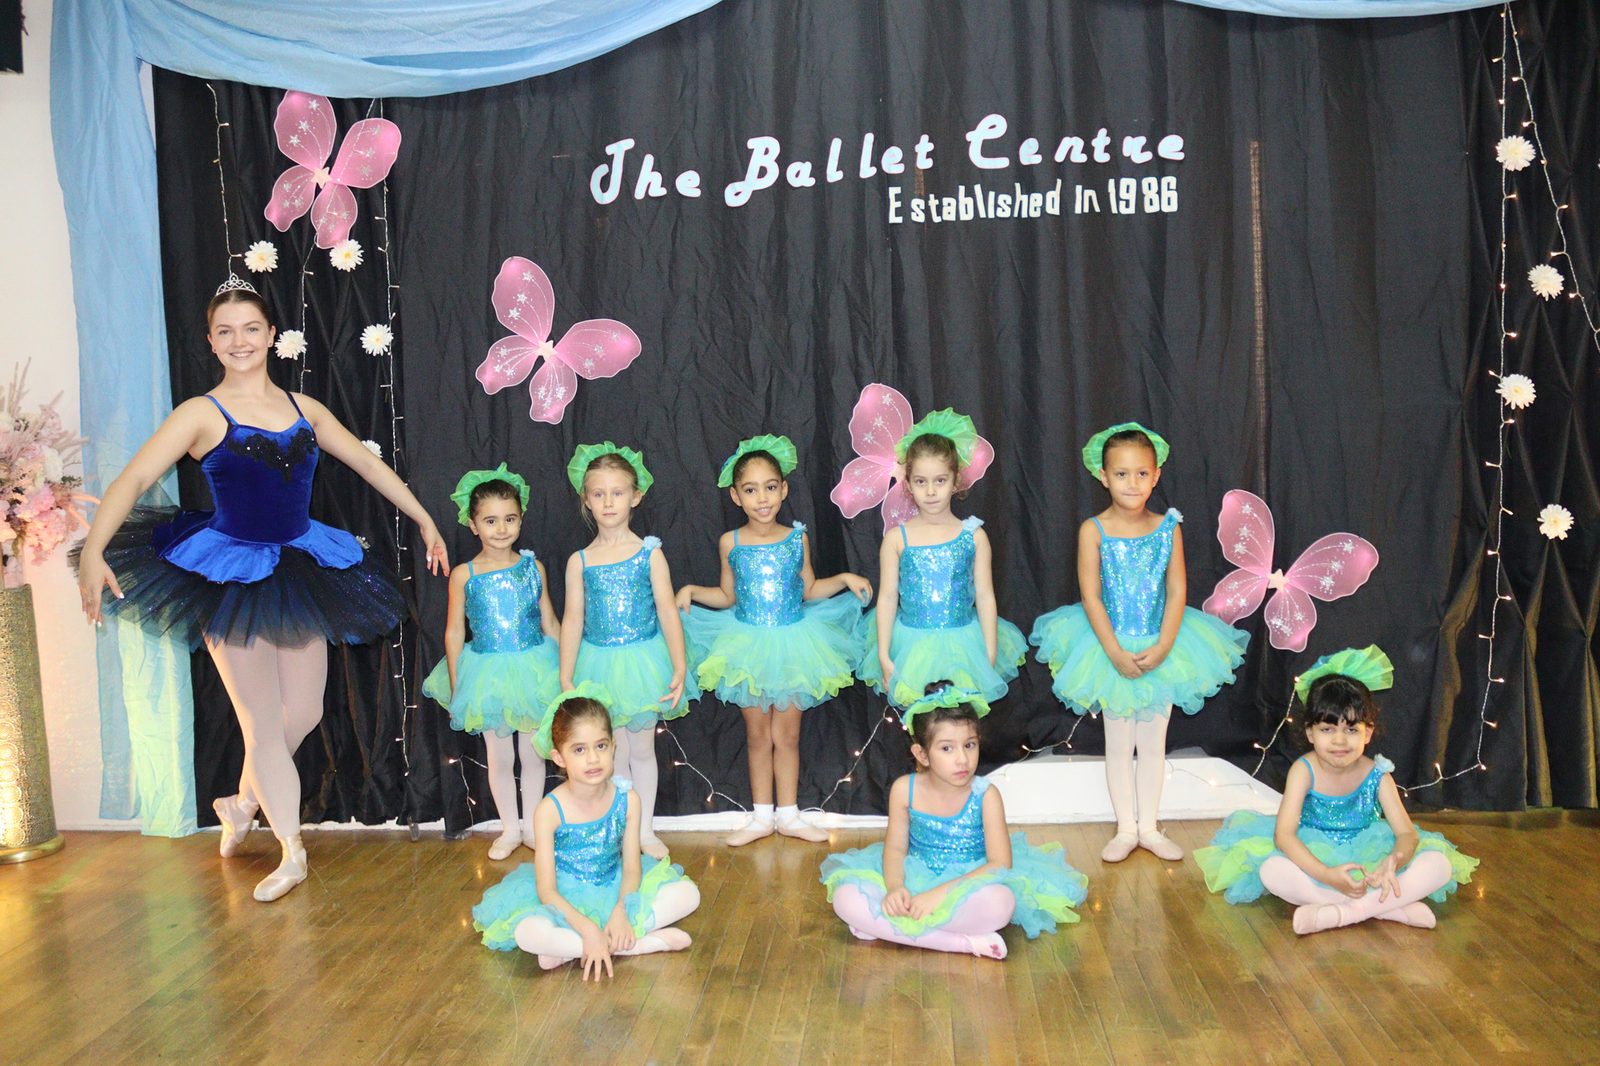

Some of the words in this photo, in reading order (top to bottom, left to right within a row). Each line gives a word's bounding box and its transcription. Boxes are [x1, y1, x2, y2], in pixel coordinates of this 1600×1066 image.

[589, 138, 703, 205] The
[723, 133, 935, 208] Ballet
[965, 113, 1186, 170] Centre
[887, 178, 1063, 225] Established
[1107, 175, 1180, 215] 1986
